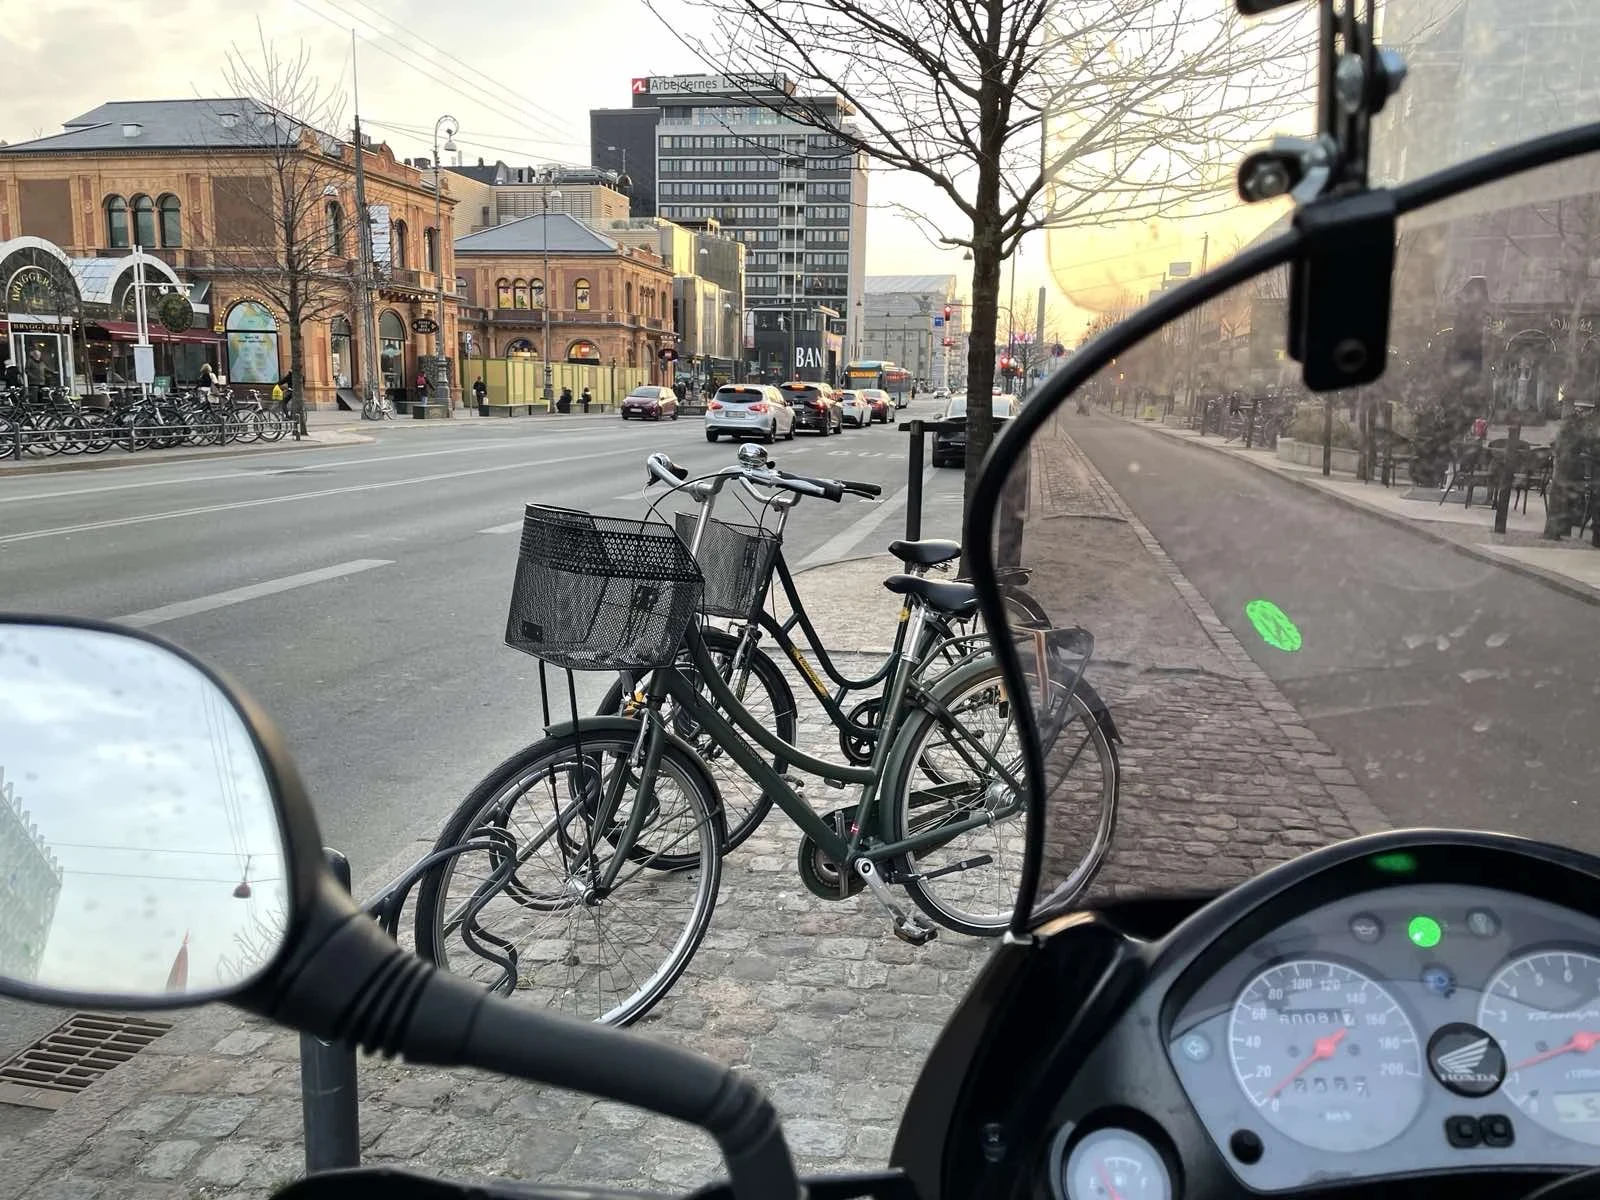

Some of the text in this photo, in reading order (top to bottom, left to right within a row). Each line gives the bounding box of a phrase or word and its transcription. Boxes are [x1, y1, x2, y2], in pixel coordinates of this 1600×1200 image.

[652, 78, 717, 92] Arbejdernes
[1291, 978, 1312, 989] 100
[1320, 980, 1341, 991] 120
[1268, 988, 1283, 1000] 80
[1346, 993, 1367, 1004] 140
[1252, 1008, 1267, 1020] 60
[1246, 1036, 1261, 1048] 40
[1256, 1065, 1271, 1077] 20
[1380, 1063, 1404, 1075] 200
[1440, 1073, 1499, 1082] HONDA
